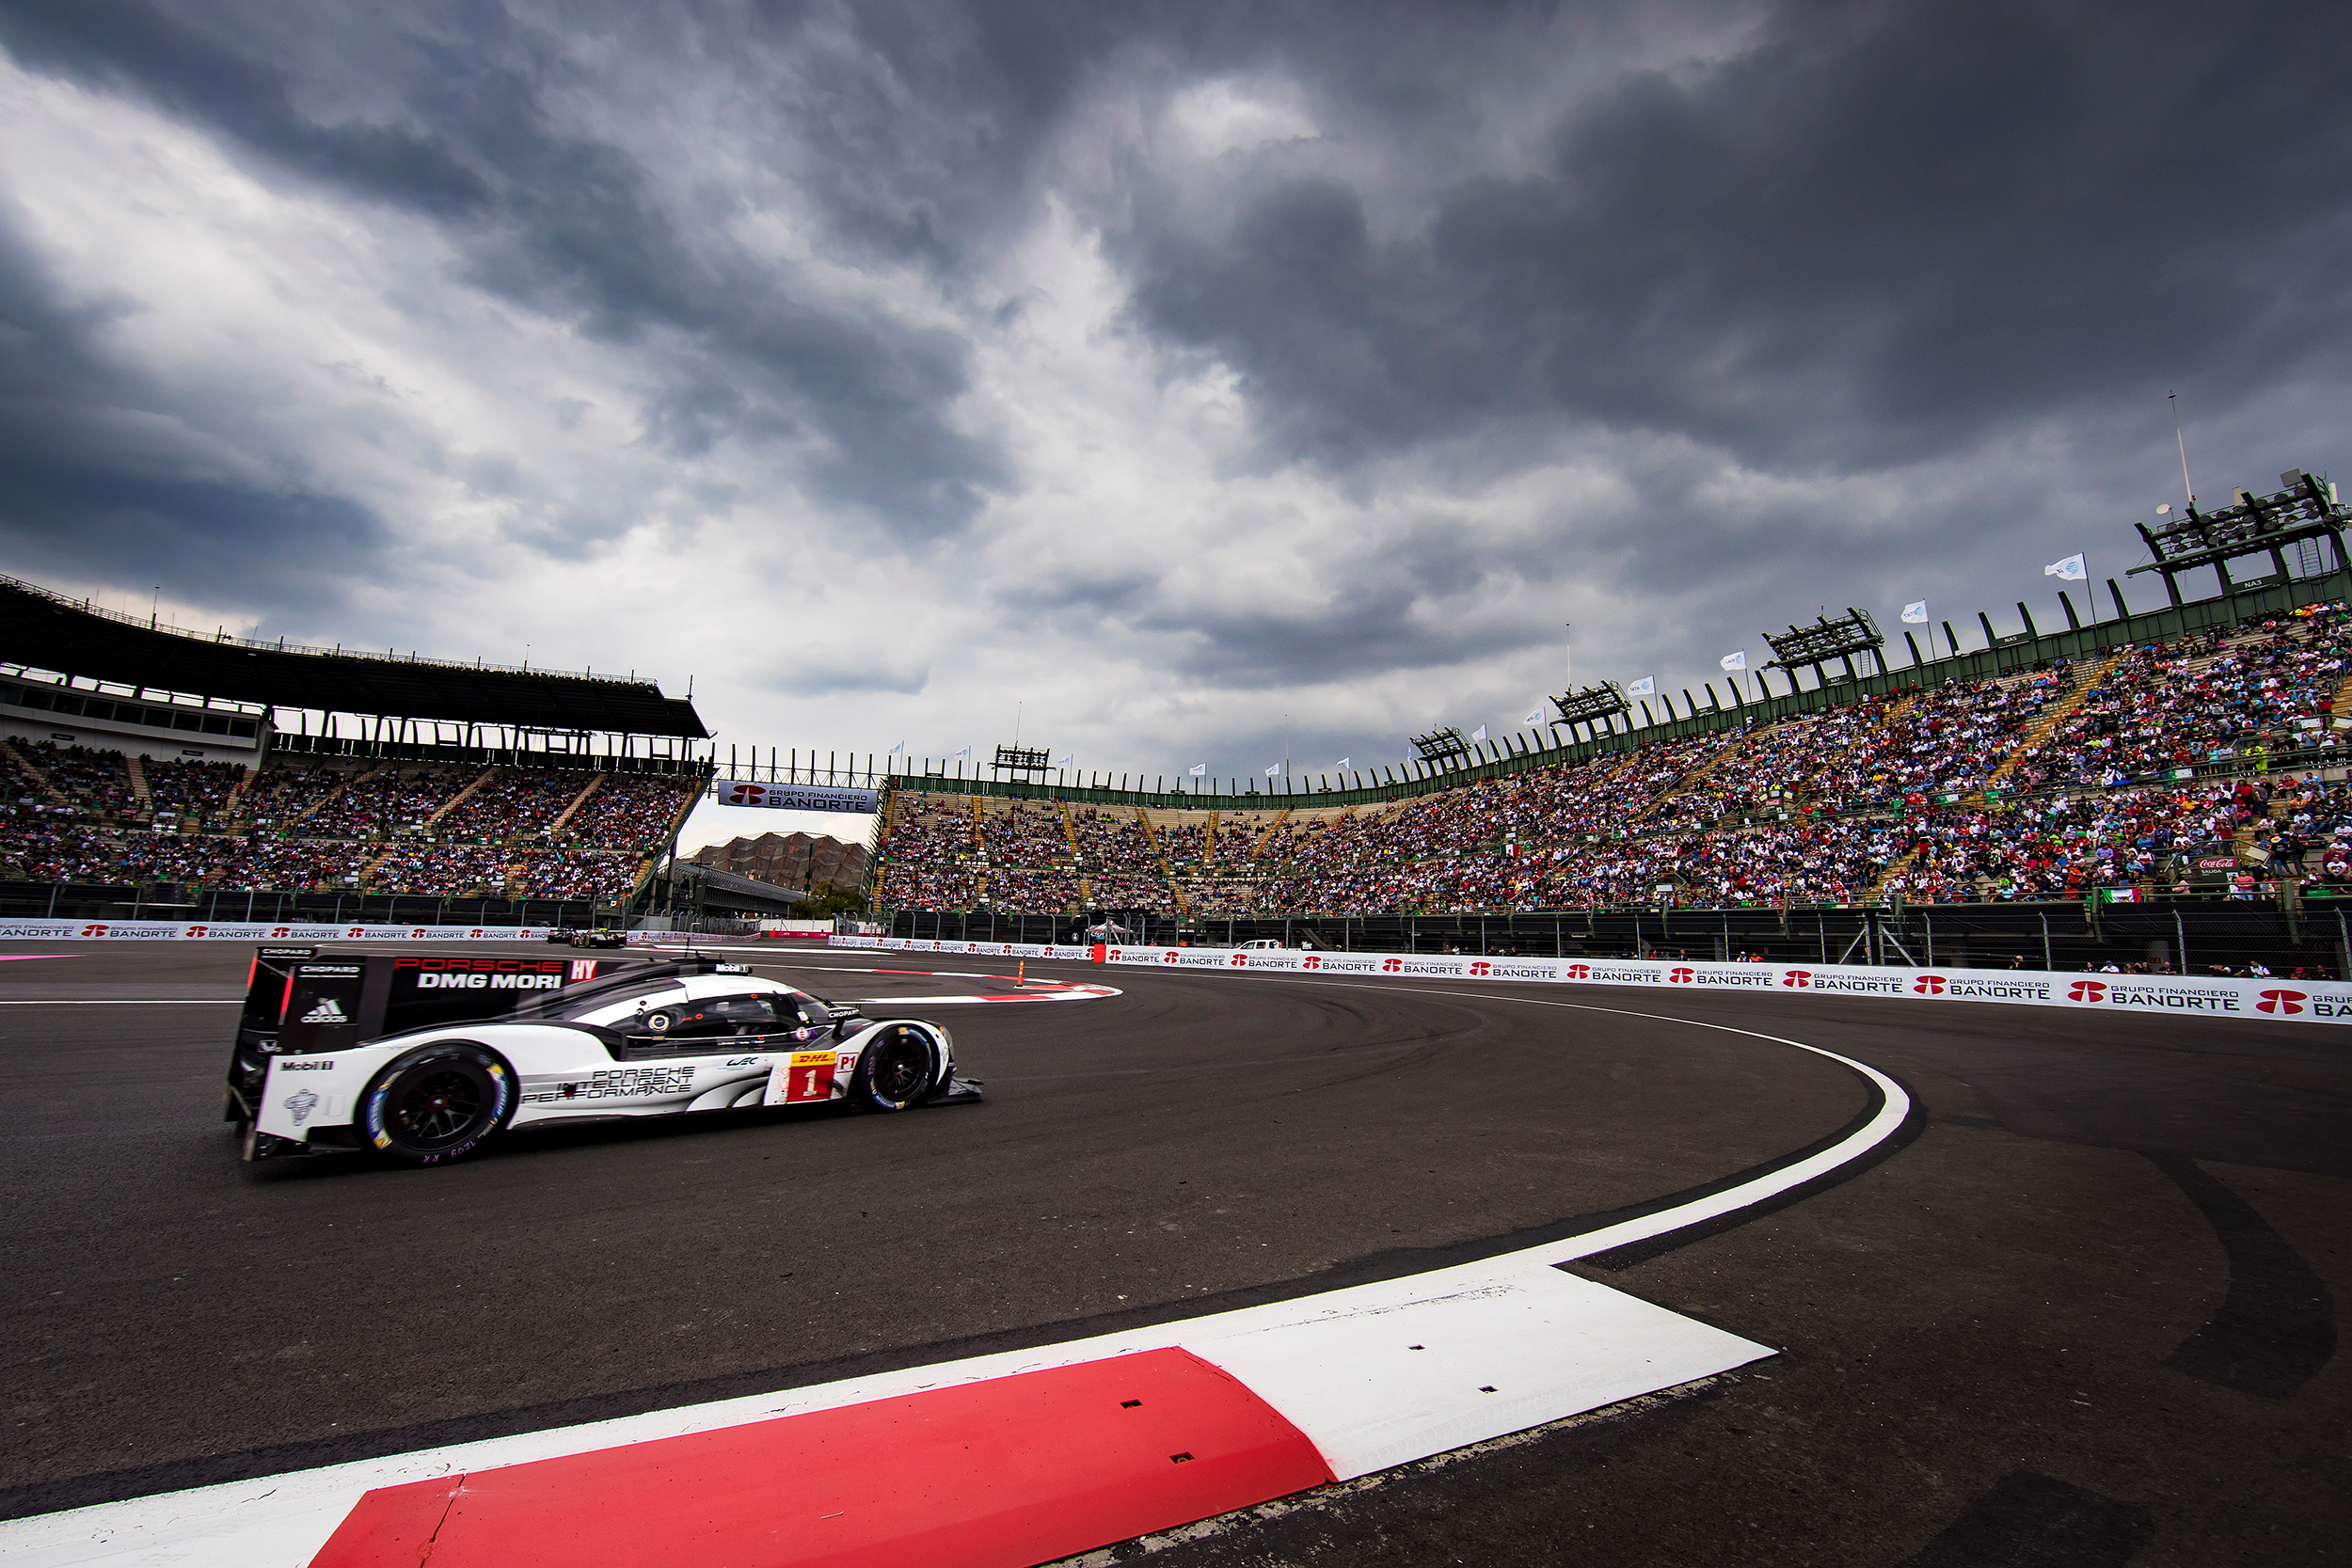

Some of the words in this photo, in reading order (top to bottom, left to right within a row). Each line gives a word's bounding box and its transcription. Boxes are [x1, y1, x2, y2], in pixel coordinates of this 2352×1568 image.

[2244, 579, 2263, 588] NA3
[769, 789, 804, 798] GRUPO
[807, 792, 867, 800] FINANCIERO
[769, 796, 866, 811] BANORTE
[393, 958, 564, 972] PORSCHE
[1179, 958, 1225, 966] BANORTE
[1322, 962, 1376, 971] BANORTE
[570, 959, 597, 979] HY
[1404, 965, 1463, 974] BANORTE
[1493, 969, 1557, 978] BANORTE
[417, 973, 488, 988] DMG
[489, 974, 563, 989] MORI
[1592, 972, 1661, 983] BANORTE
[1696, 975, 1773, 987] BANORTE
[1847, 974, 1903, 983] FINANCIERO
[1814, 979, 1903, 993] BANORTE
[2110, 985, 2154, 993] GRUPO
[2158, 988, 2239, 998] FINANCIERO
[1950, 985, 2051, 1000] BANORTE
[2112, 992, 2241, 1011] BANORTE
[300, 1015, 348, 1023] adidas
[726, 1056, 759, 1066] WEC
[798, 1053, 830, 1063] DHL
[840, 1055, 856, 1070] P1
[279, 1061, 319, 1071] Mobil
[593, 1066, 695, 1080] PORSCHE
[556, 1075, 693, 1091] INTELLIGENT
[803, 1069, 818, 1097] 1
[521, 1084, 691, 1104] PERFORMANCE
